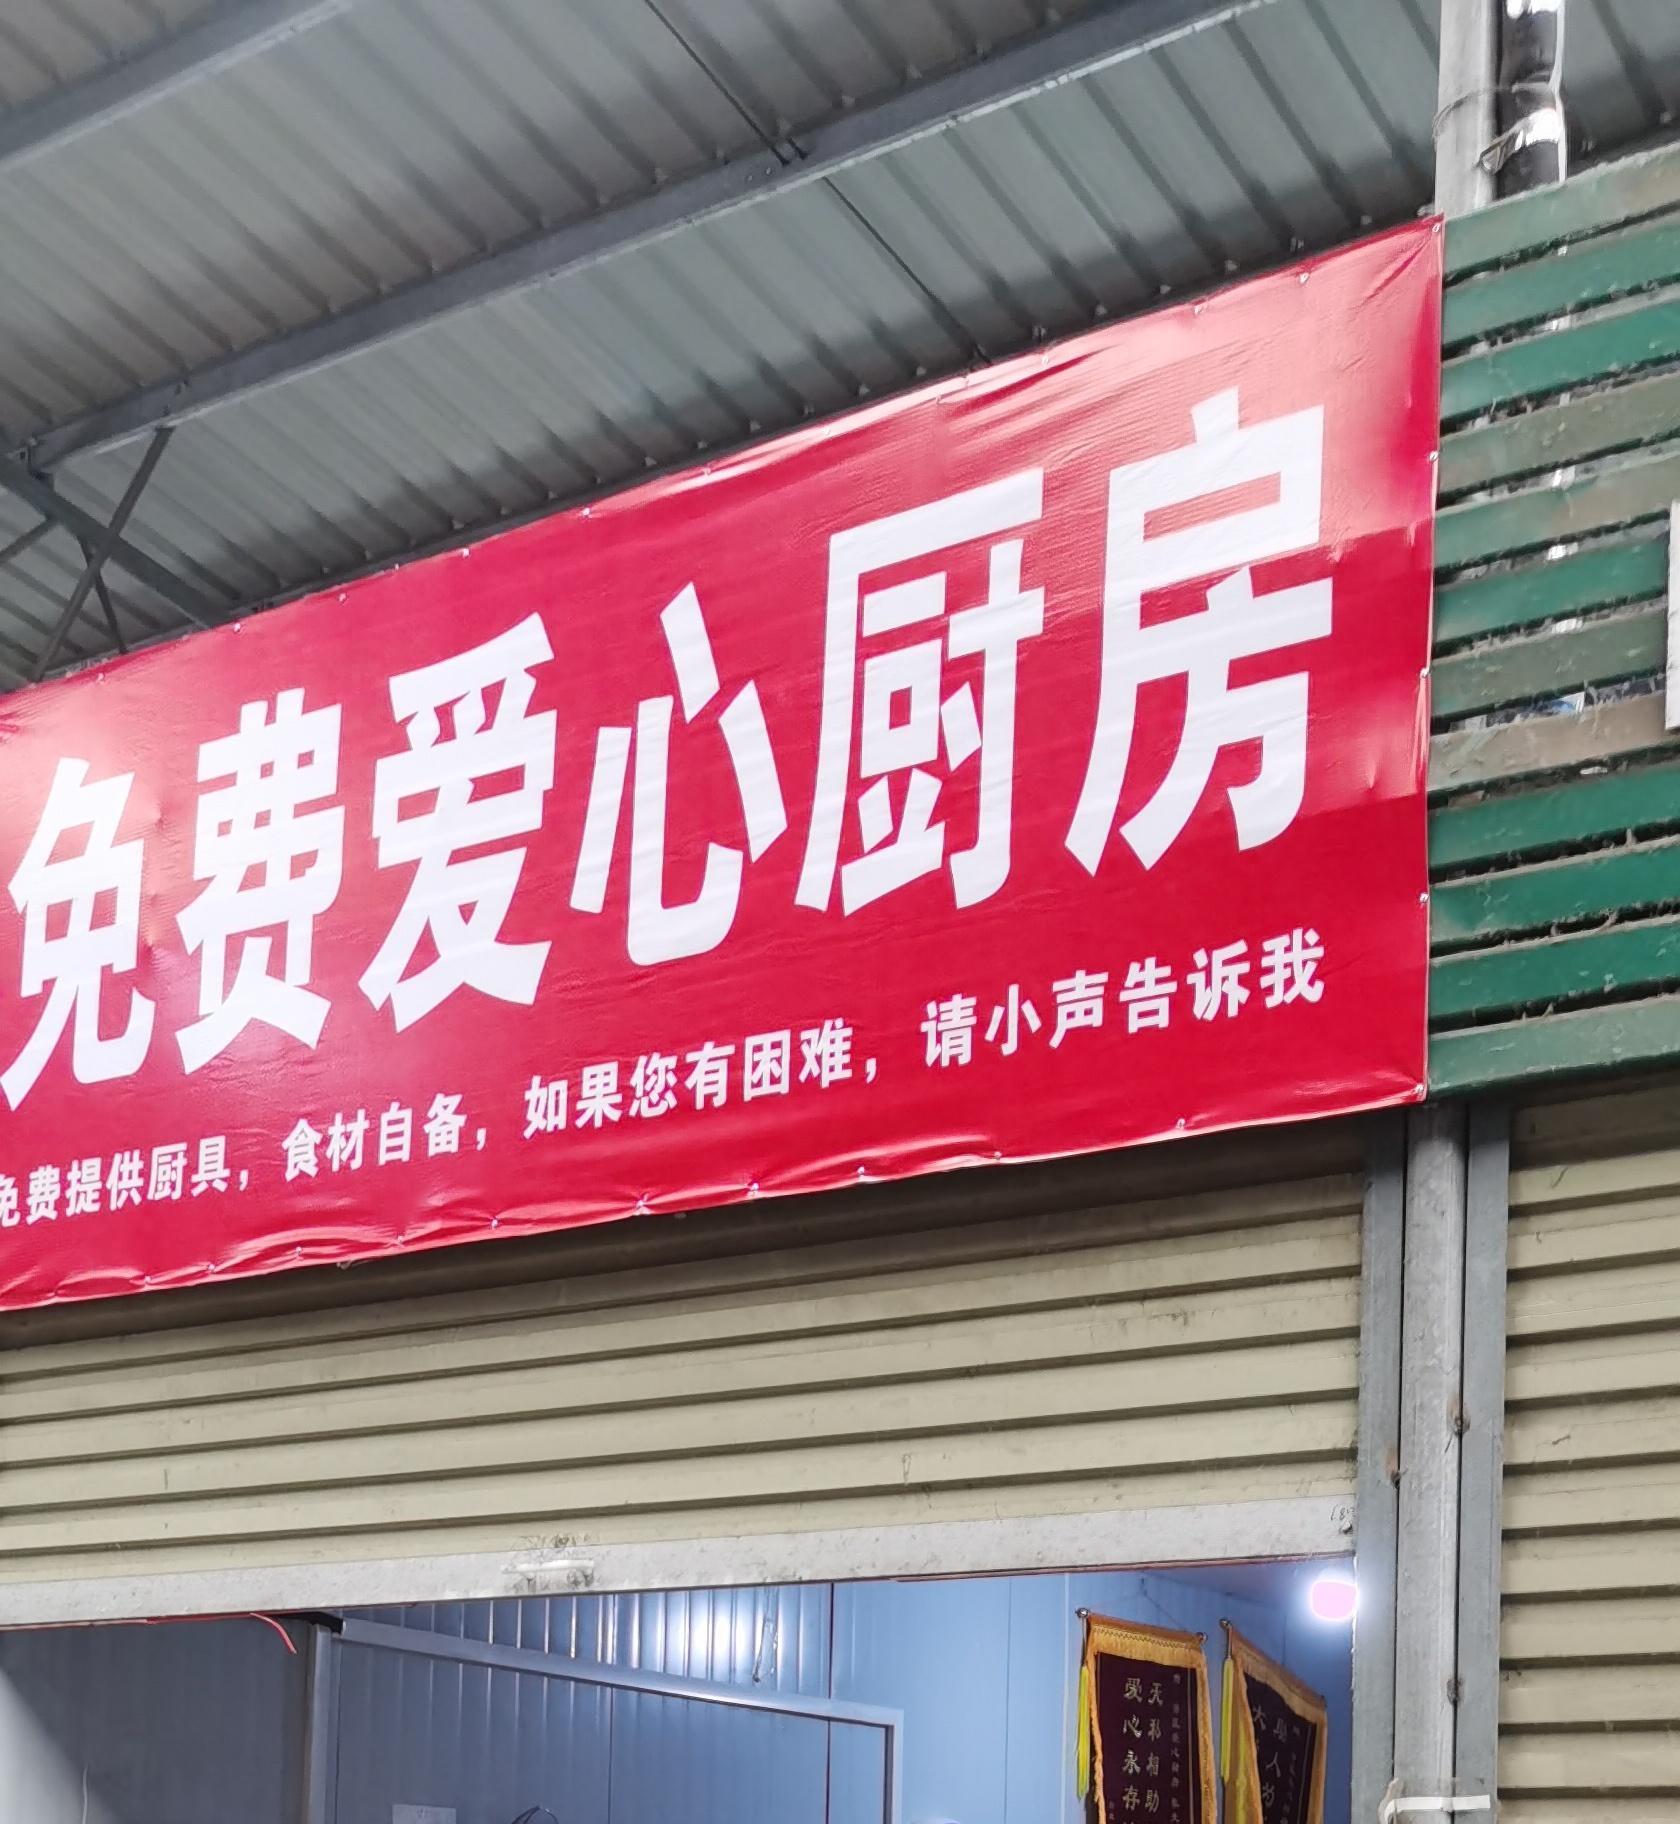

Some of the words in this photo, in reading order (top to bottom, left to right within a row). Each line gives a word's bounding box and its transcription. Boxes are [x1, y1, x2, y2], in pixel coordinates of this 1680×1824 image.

[0, 386, 1334, 1112] 免费爱心厨房
